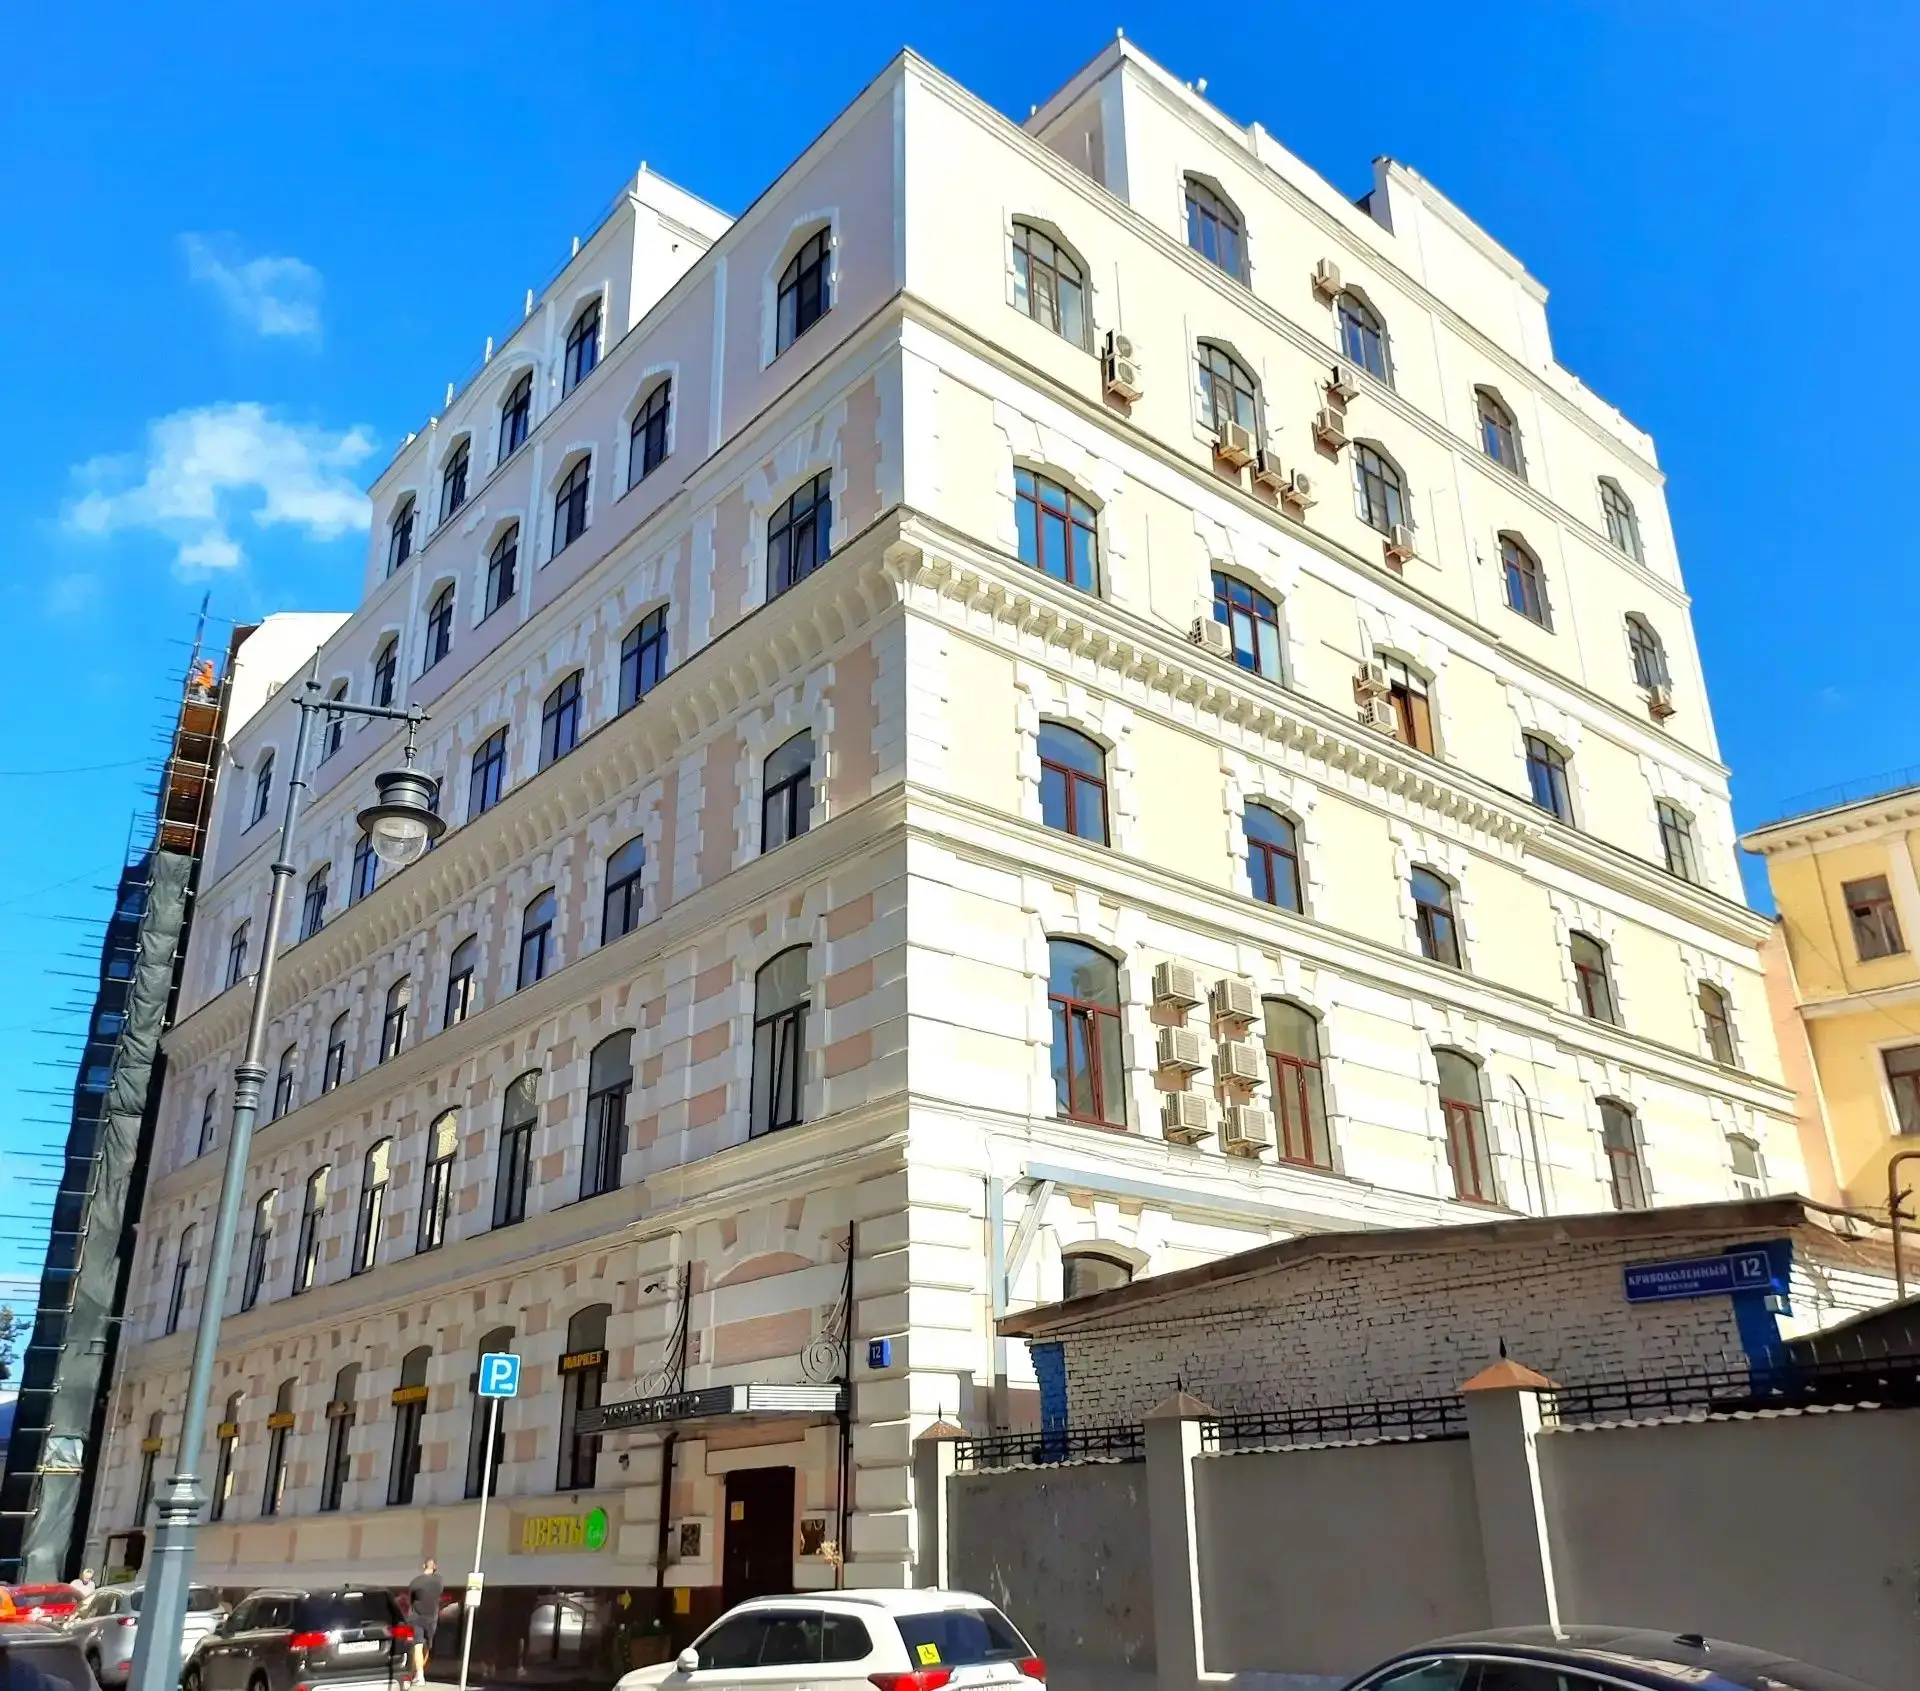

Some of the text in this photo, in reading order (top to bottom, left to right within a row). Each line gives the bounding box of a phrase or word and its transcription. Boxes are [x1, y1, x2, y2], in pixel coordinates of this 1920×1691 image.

[1628, 1257, 1762, 1286] КРИВОКОЛЕННЫЙ 12
[872, 1346, 881, 1359] 12
[490, 1359, 512, 1391] P
[523, 1515, 585, 1548] ЦВЕТЫ
